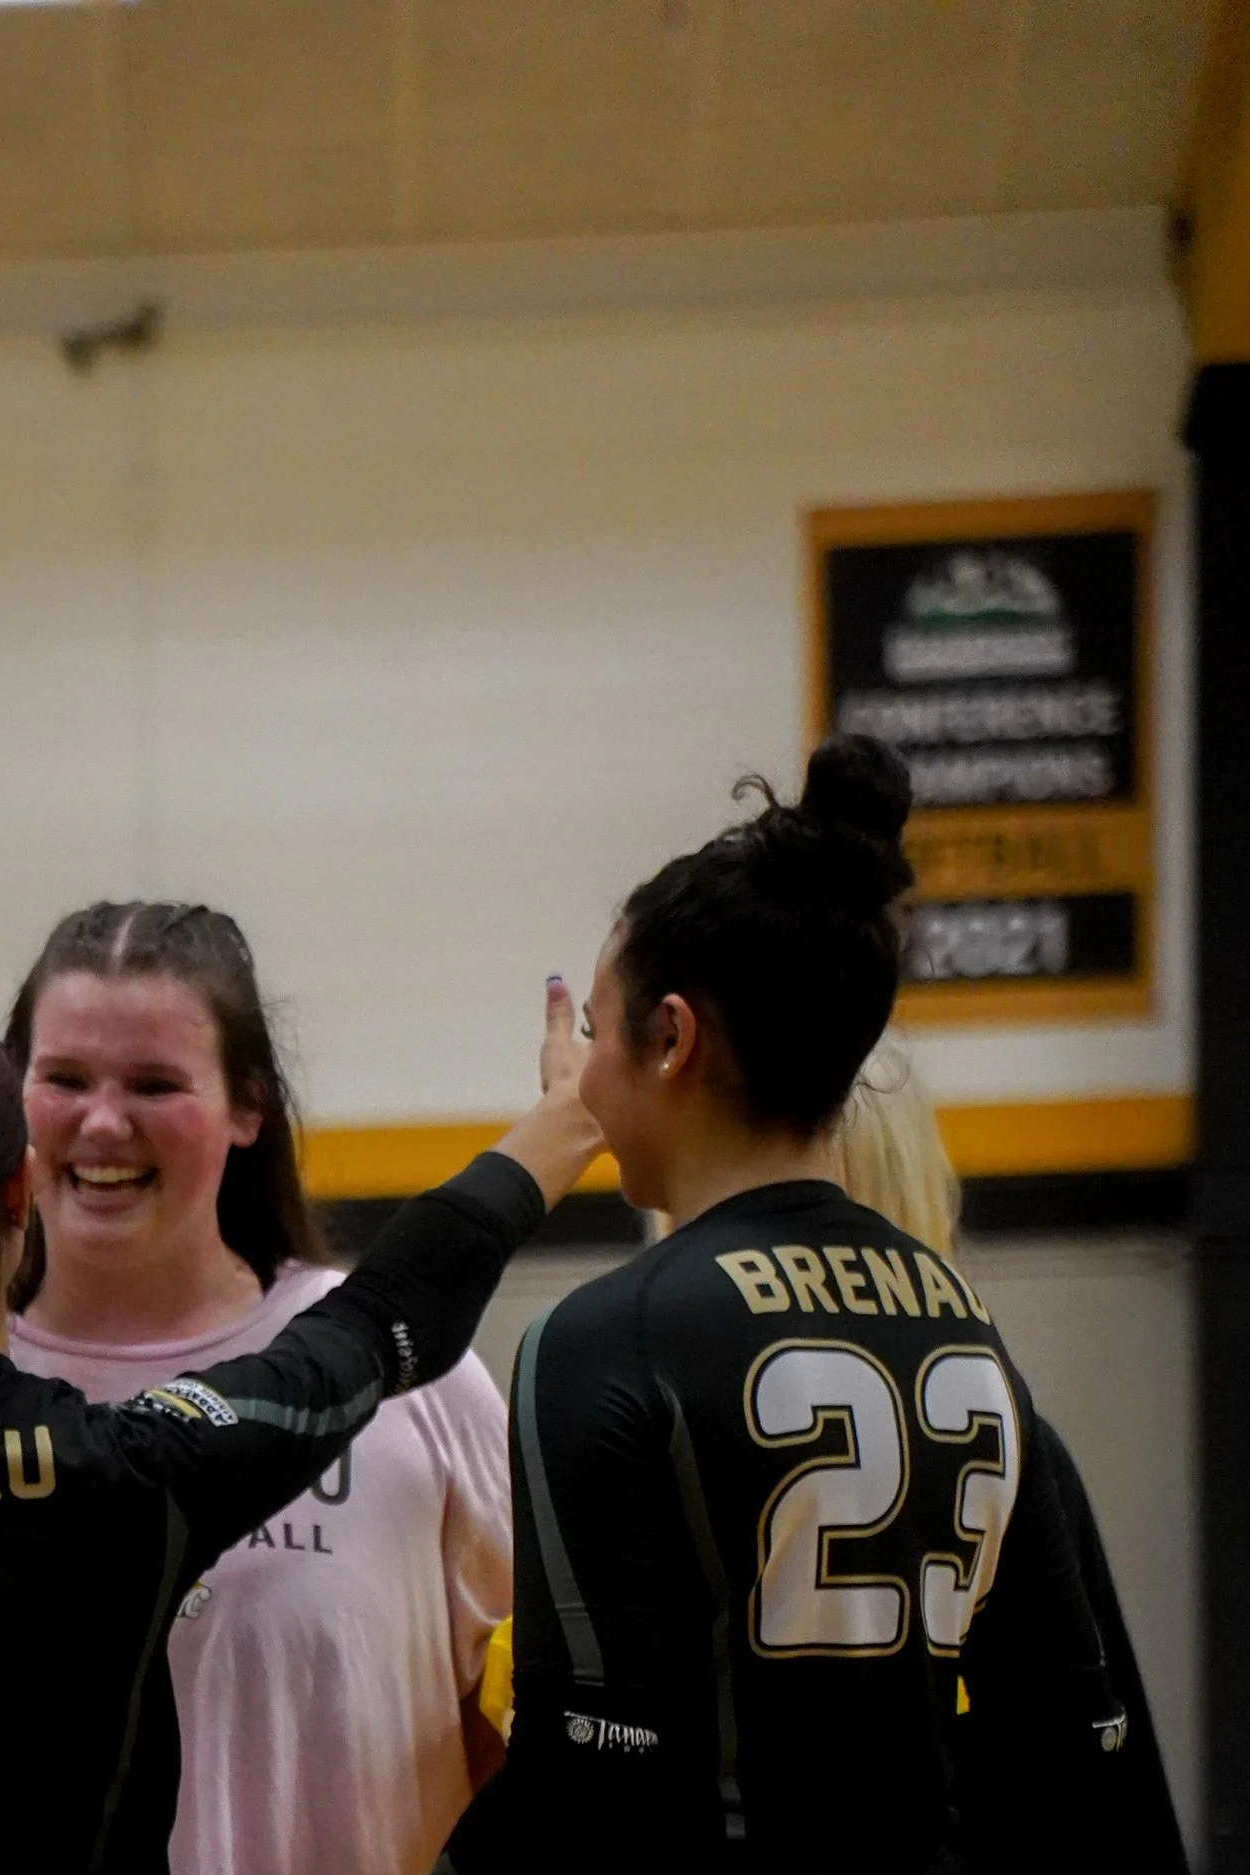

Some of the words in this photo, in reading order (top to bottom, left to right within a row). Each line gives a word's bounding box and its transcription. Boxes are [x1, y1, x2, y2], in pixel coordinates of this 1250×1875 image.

[906, 744, 1113, 801] AMPIONS
[915, 903, 1068, 977] 2021
[743, 1338, 1020, 1658] 23
